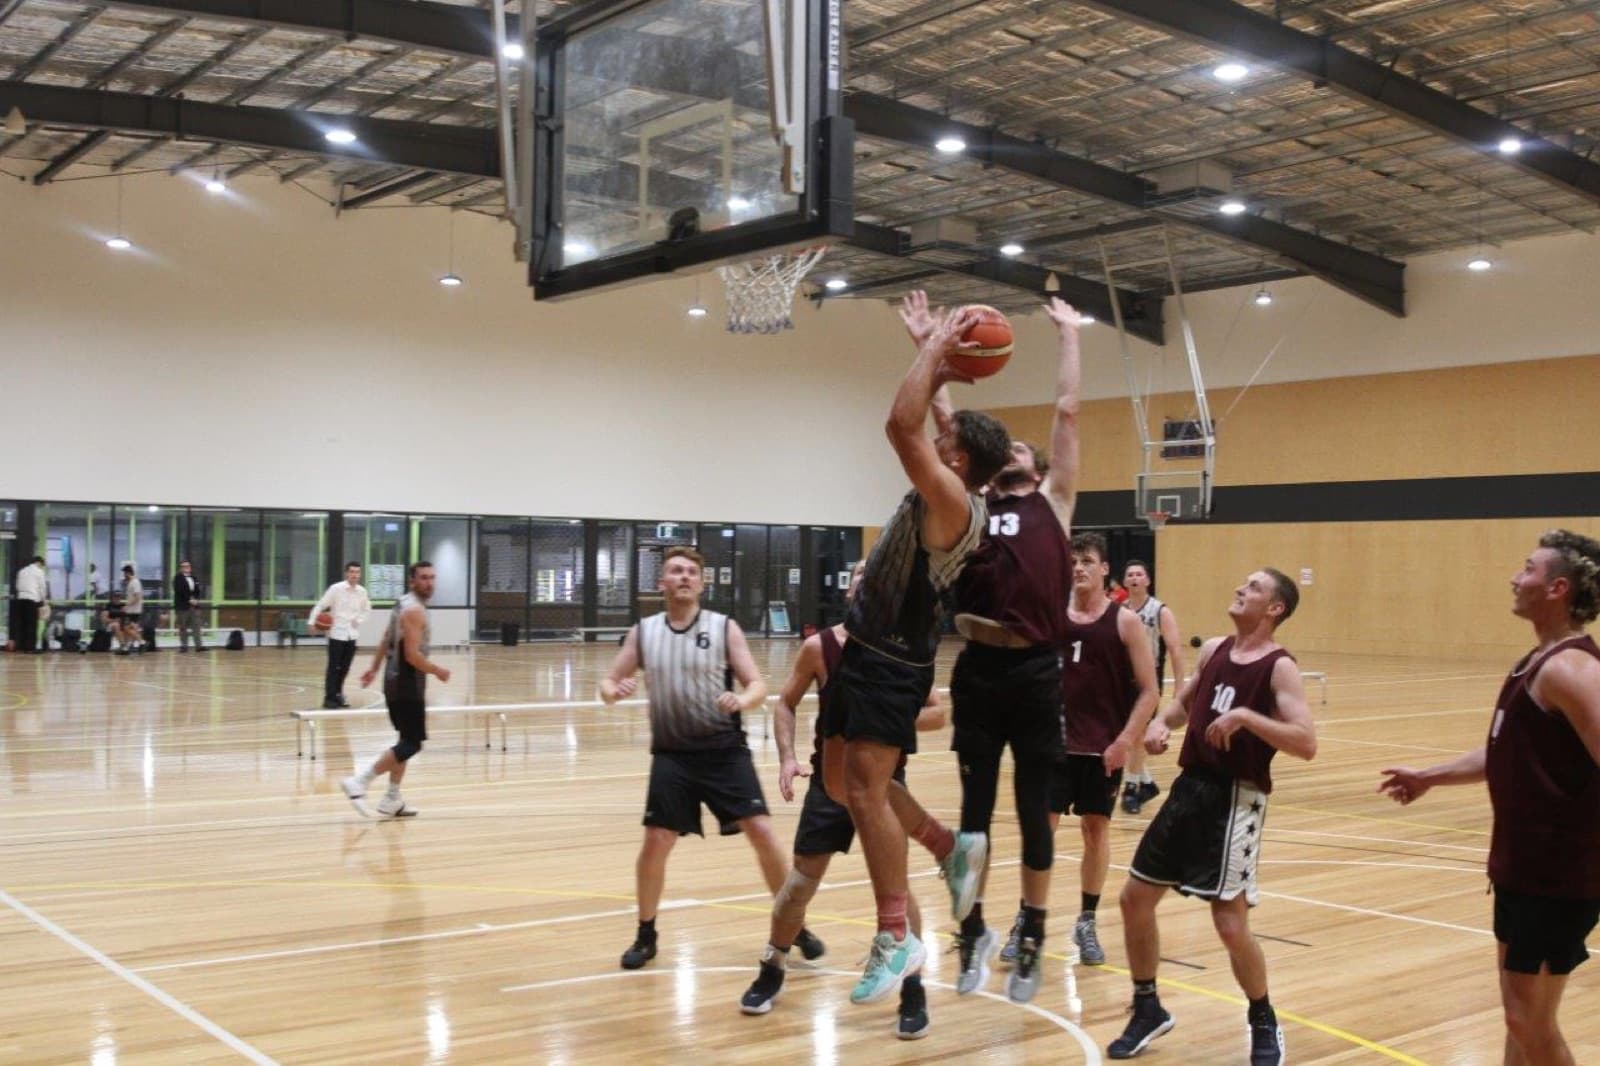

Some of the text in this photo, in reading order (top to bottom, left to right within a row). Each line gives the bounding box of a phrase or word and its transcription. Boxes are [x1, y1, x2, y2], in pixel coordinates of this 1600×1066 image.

[989, 513, 1020, 536] 13
[696, 632, 710, 649] 6
[1211, 683, 1236, 713] 10
